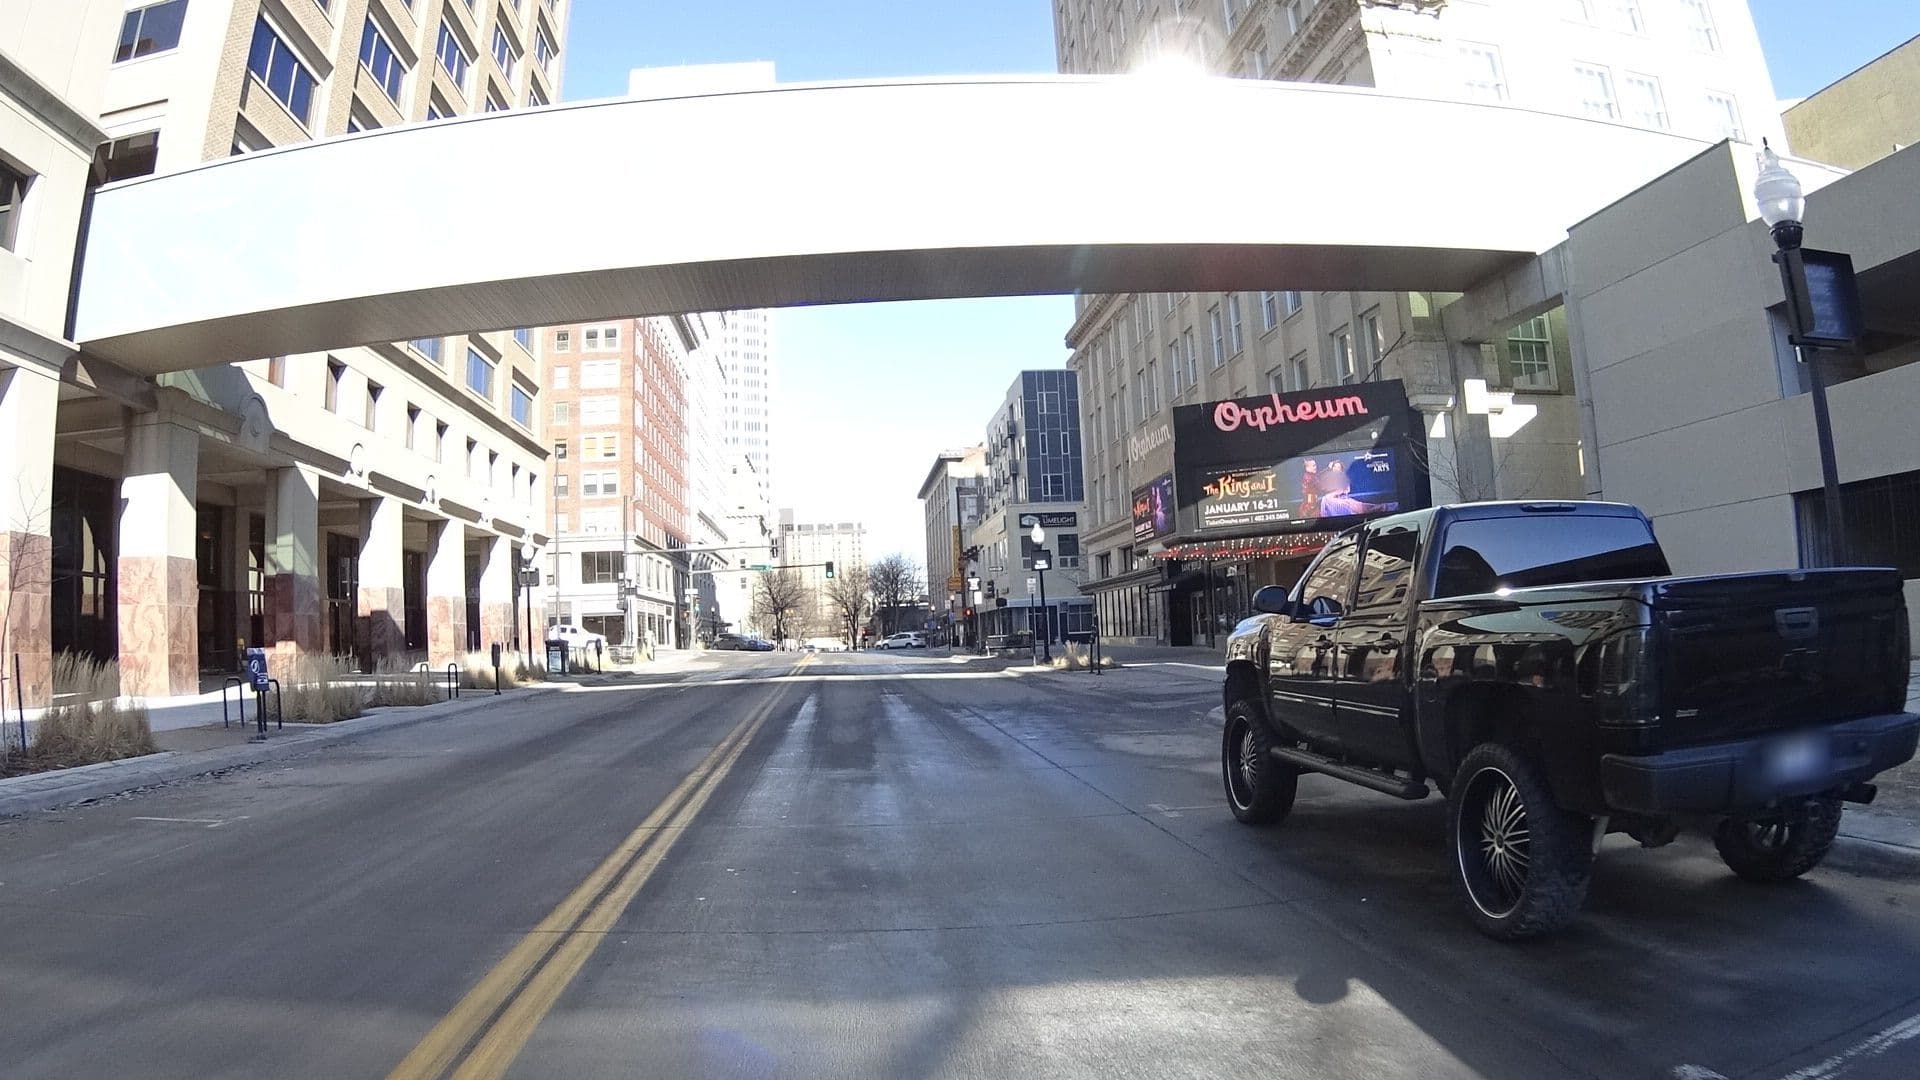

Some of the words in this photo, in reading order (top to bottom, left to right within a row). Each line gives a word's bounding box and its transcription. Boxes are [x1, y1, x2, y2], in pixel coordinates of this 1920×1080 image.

[1214, 393, 1369, 433] Orpheum
[1129, 424, 1171, 462] Orpheum
[1203, 484, 1219, 496] The
[1217, 474, 1250, 501] King
[1250, 479, 1266, 491] and
[1264, 474, 1277, 493] I
[1042, 516, 1075, 524] LIMELIGHT
[1204, 501, 1250, 516] JANUARY
[1252, 498, 1279, 511] 16-21
